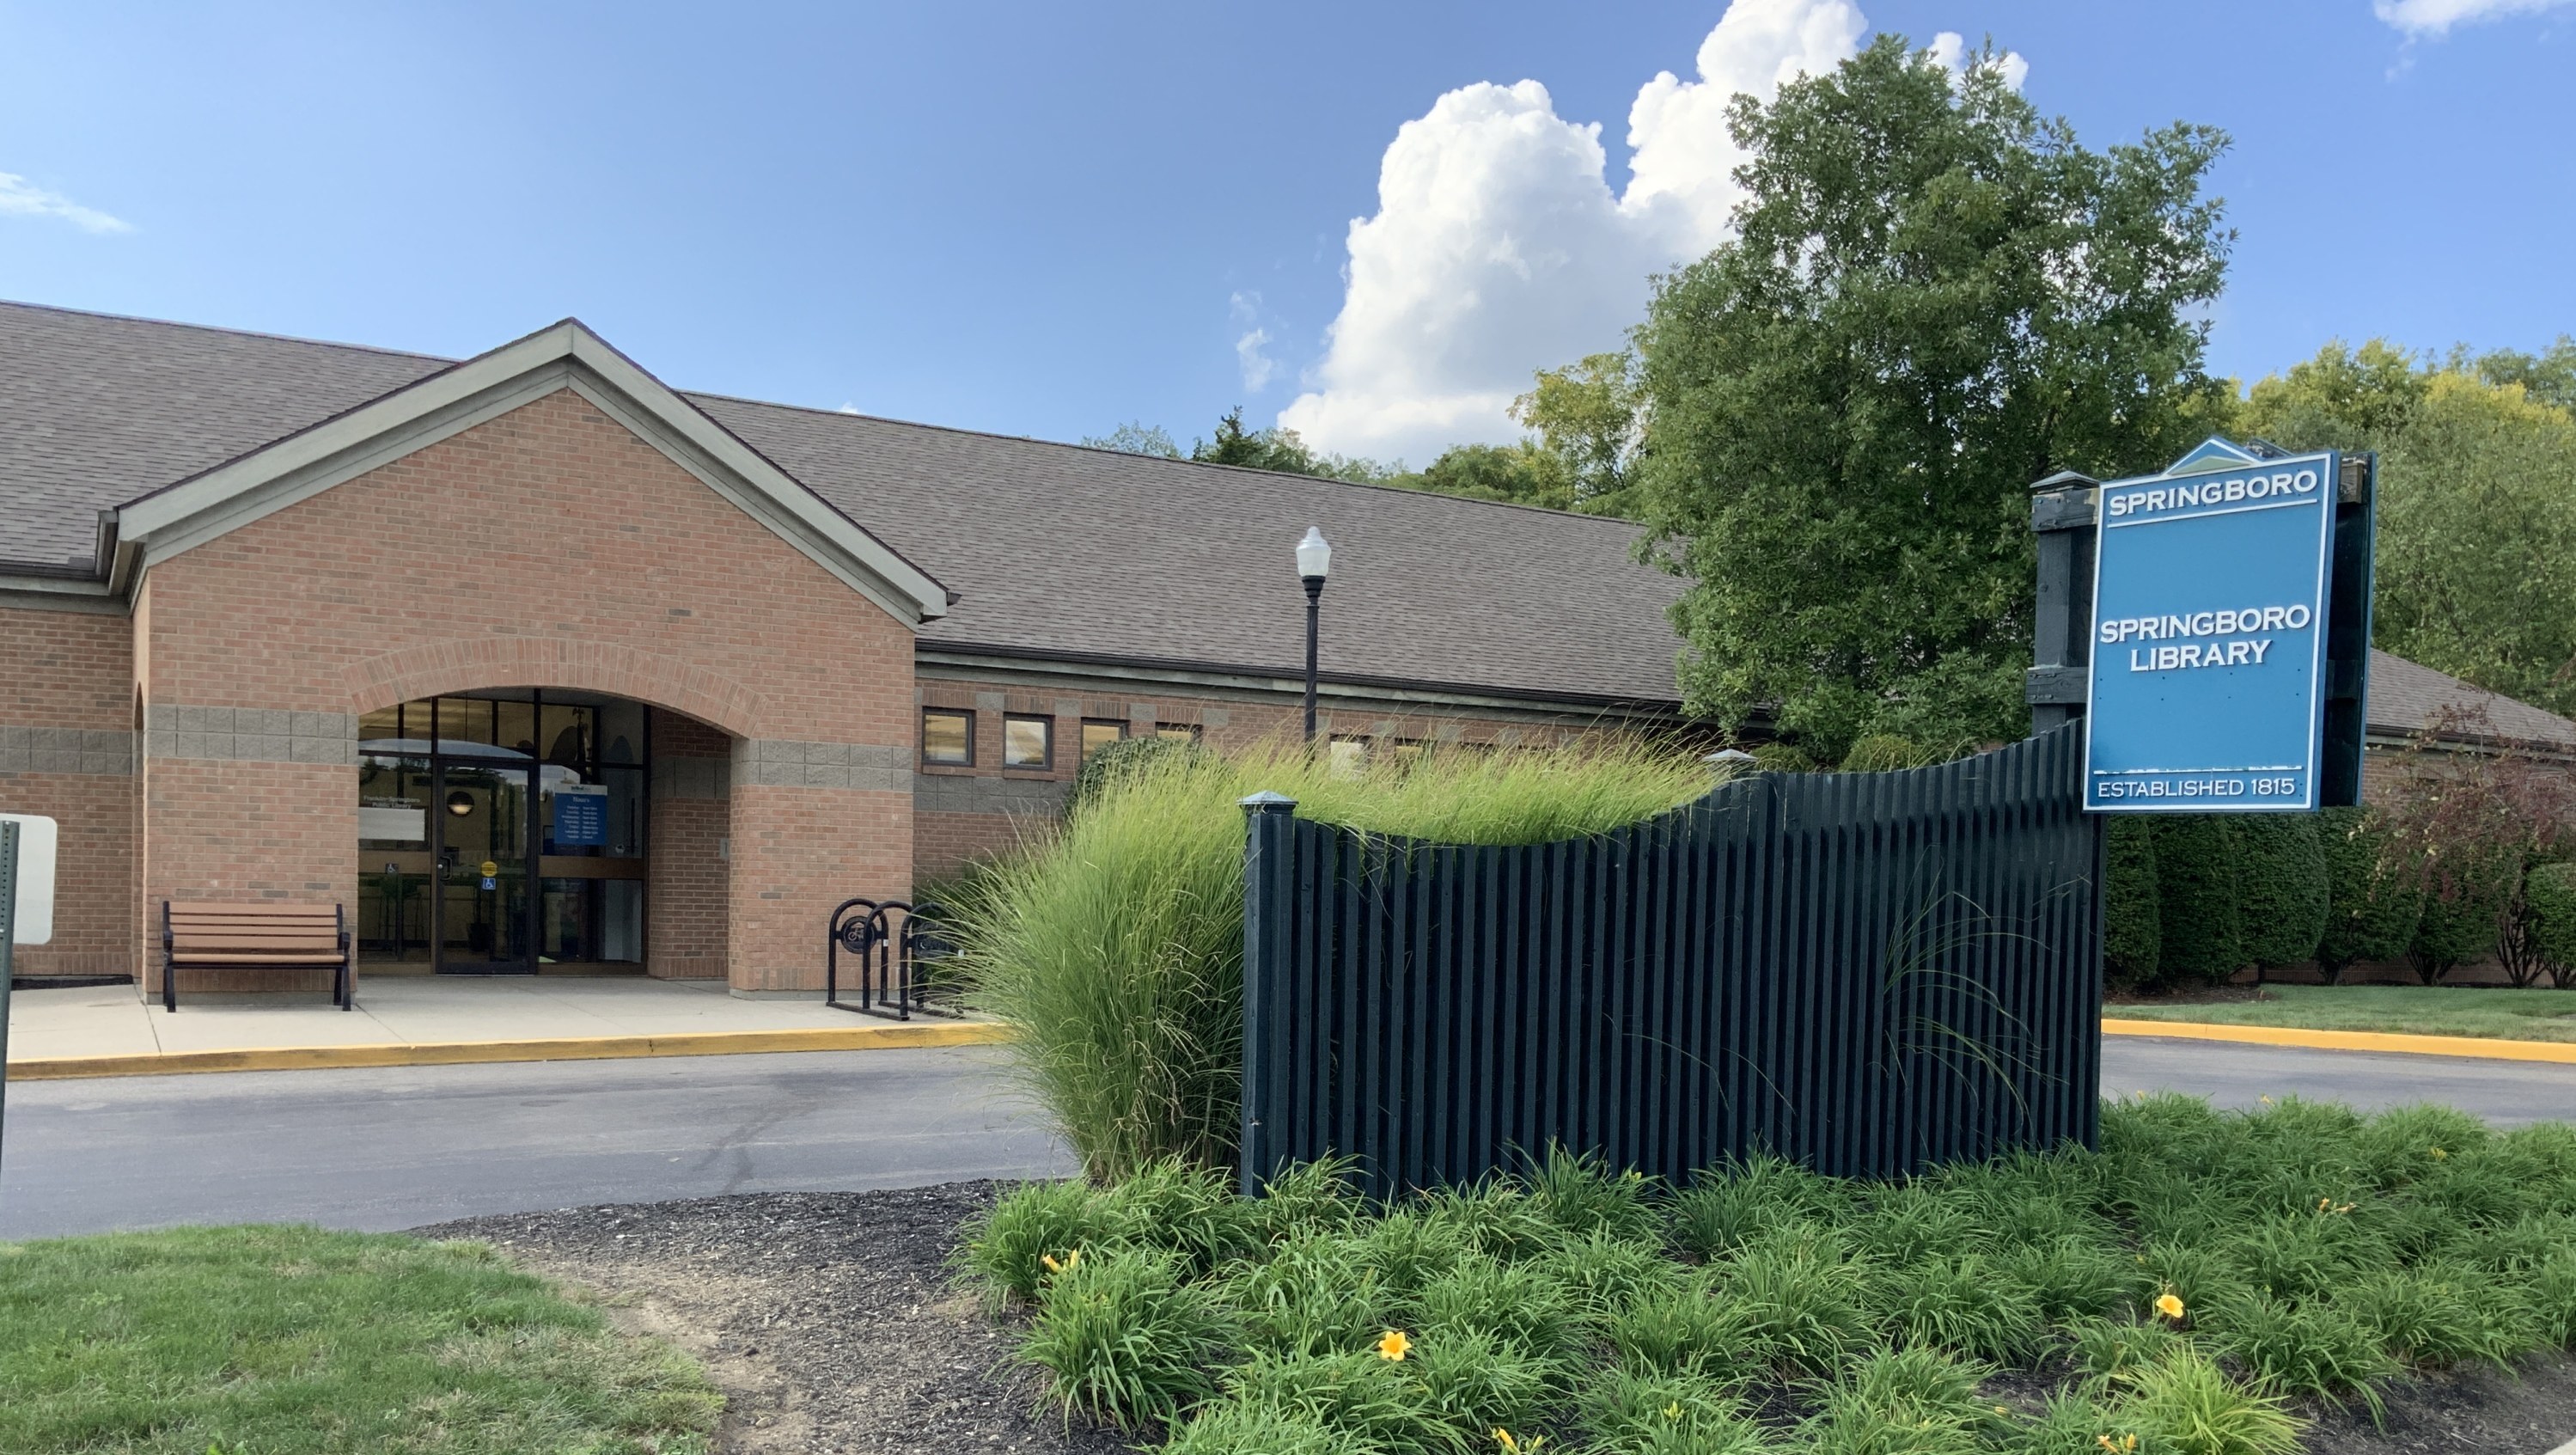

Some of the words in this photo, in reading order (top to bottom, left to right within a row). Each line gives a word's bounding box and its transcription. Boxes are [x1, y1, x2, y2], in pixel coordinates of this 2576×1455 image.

[2109, 469, 2318, 516] SPRINGBORO
[2100, 604, 2310, 643] SPRINGBORO
[2130, 639, 2272, 671] LIBRARY
[2097, 779, 2244, 798] ESTABLISHED
[2250, 778, 2295, 795] 1815
